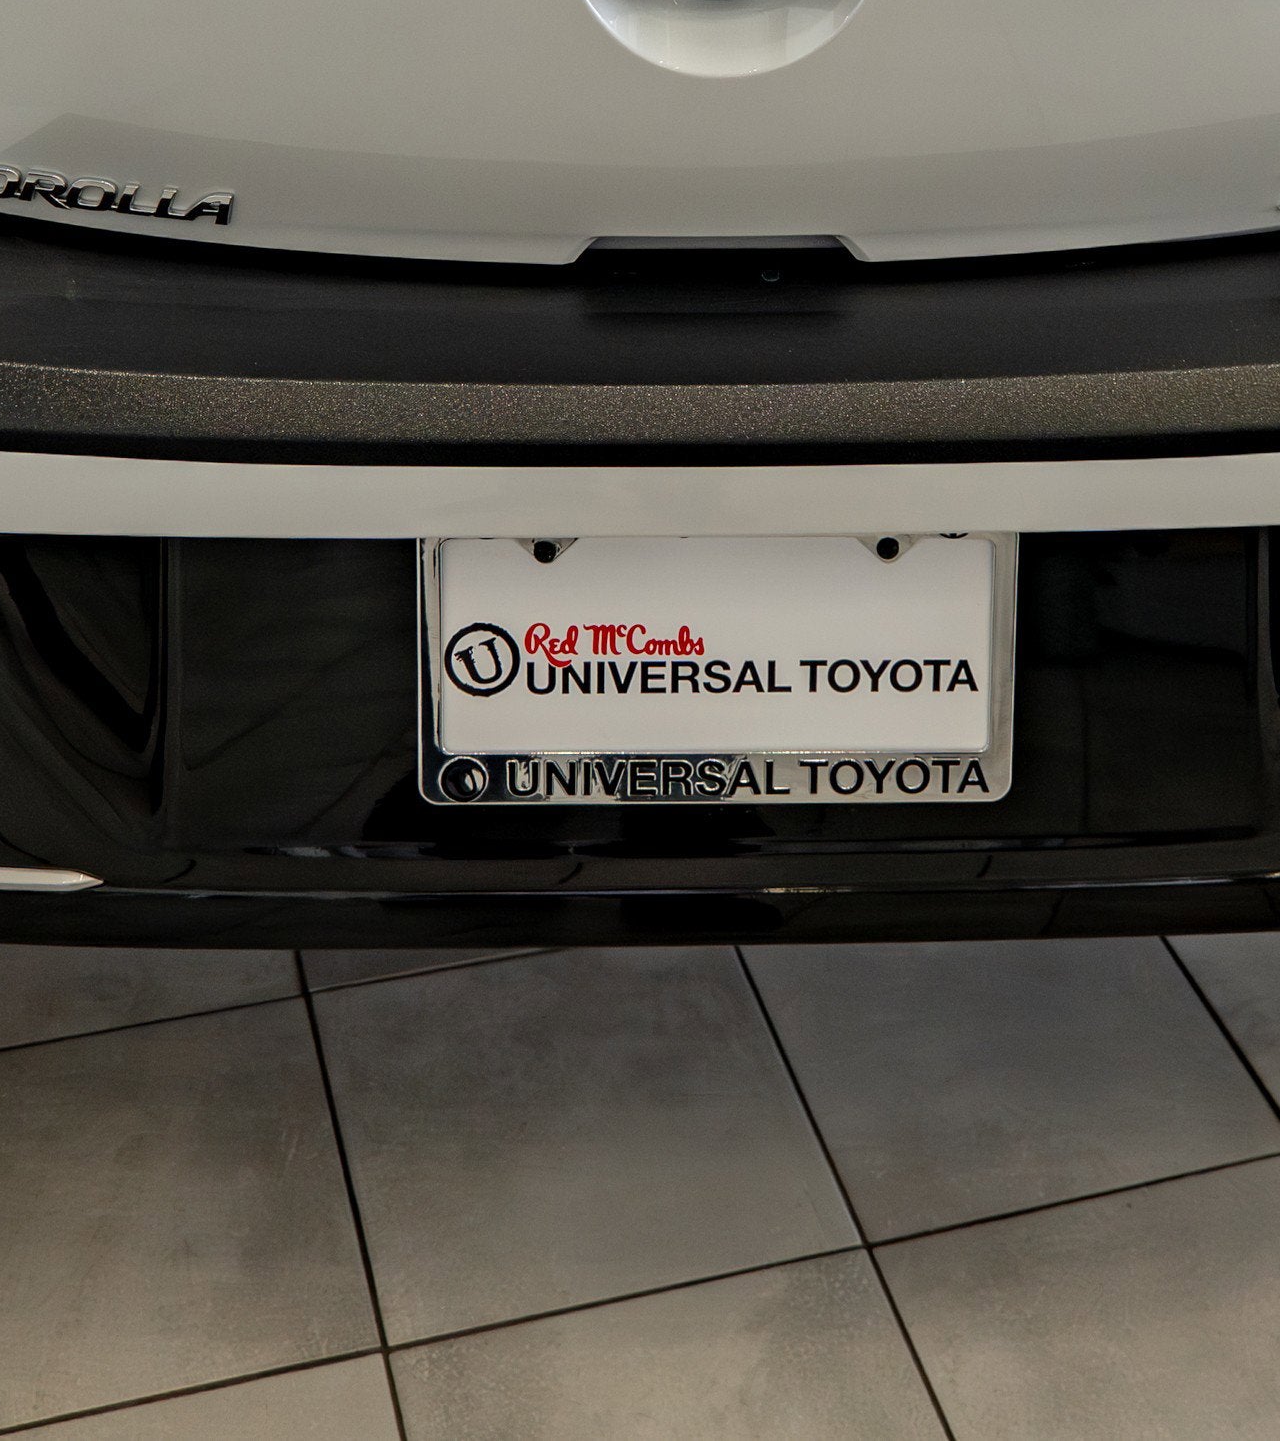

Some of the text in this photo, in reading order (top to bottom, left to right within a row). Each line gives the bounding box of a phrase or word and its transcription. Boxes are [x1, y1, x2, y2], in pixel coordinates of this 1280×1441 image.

[524, 622, 705, 667] Red McCombs
[526, 659, 979, 695] UNIVERSAL TOYOTA
[506, 758, 990, 798] UNIVERSAL TOYOTA
